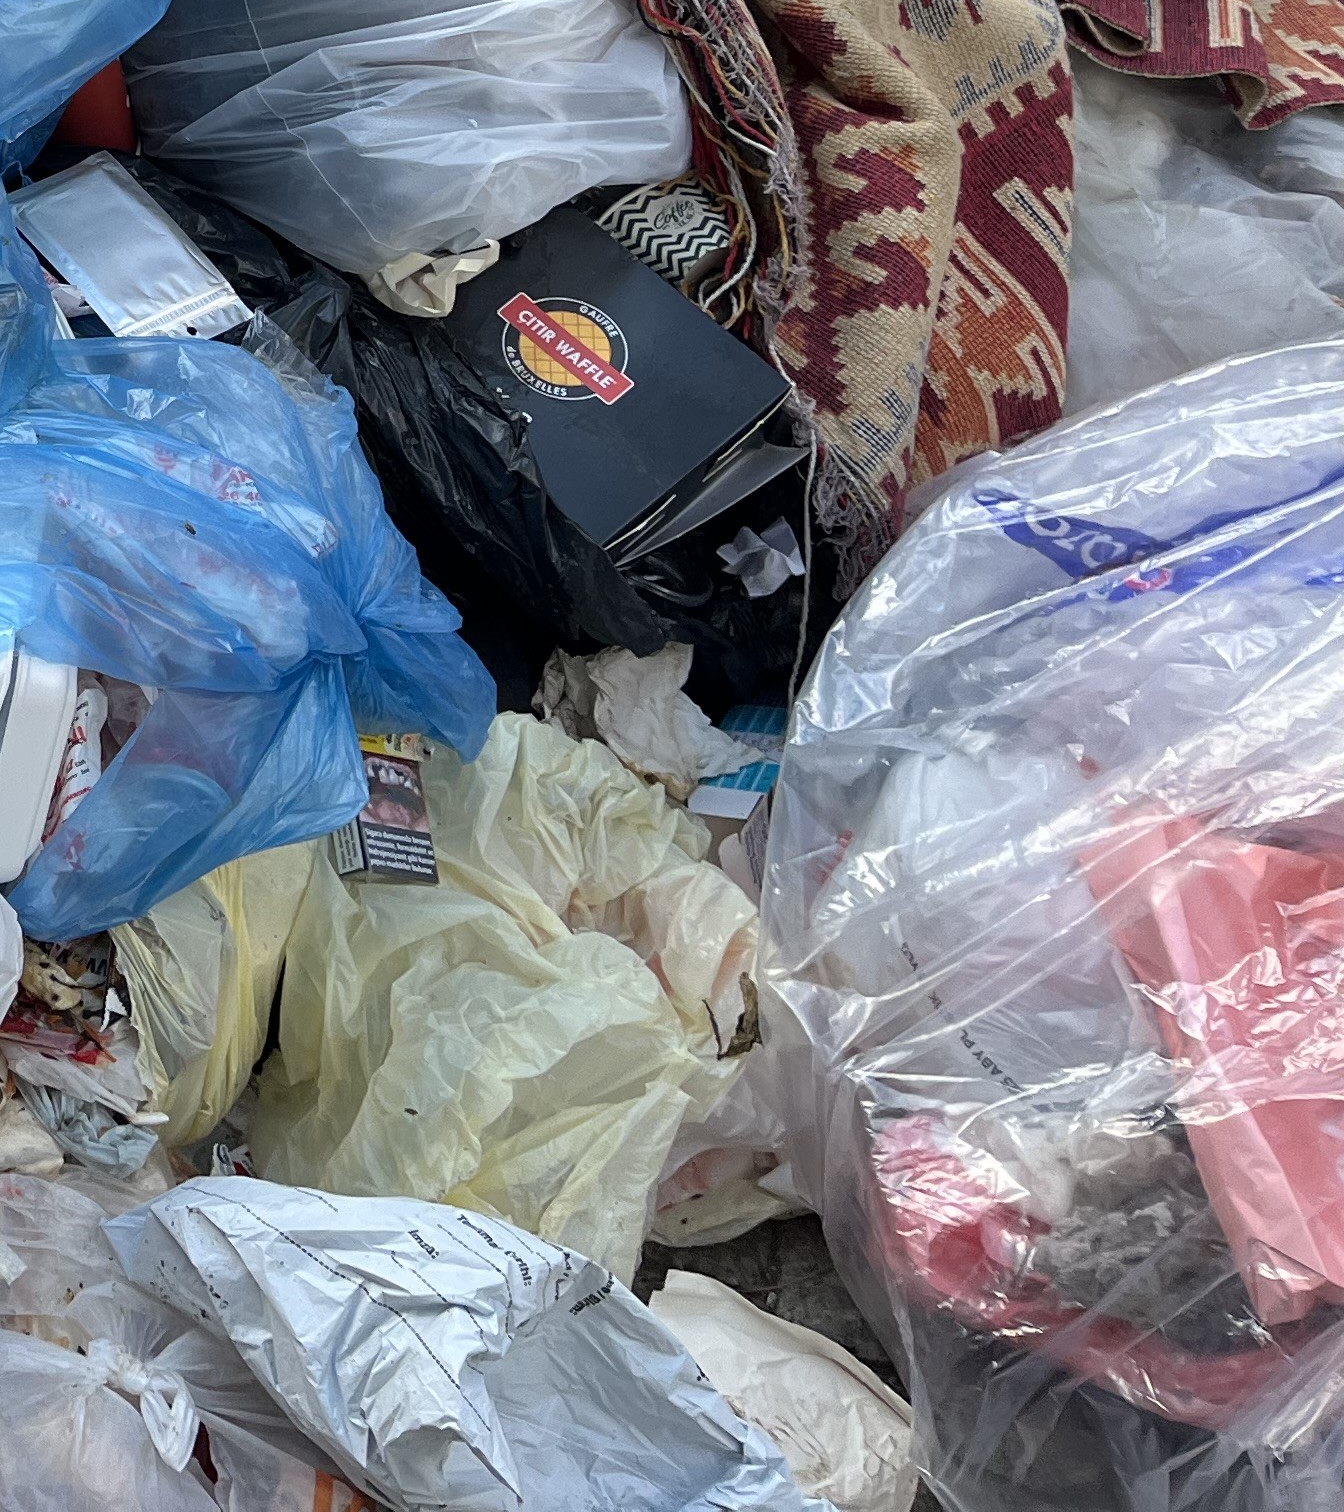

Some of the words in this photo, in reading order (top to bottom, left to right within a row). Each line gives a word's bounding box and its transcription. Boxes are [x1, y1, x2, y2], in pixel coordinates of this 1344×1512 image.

[579, 304, 620, 339] GAUFRE
[516, 310, 557, 344] ÇITIR
[555, 339, 615, 389] WAFFLE
[511, 357, 568, 397] BRUXELLES
[382, 831, 412, 843] dumanında
